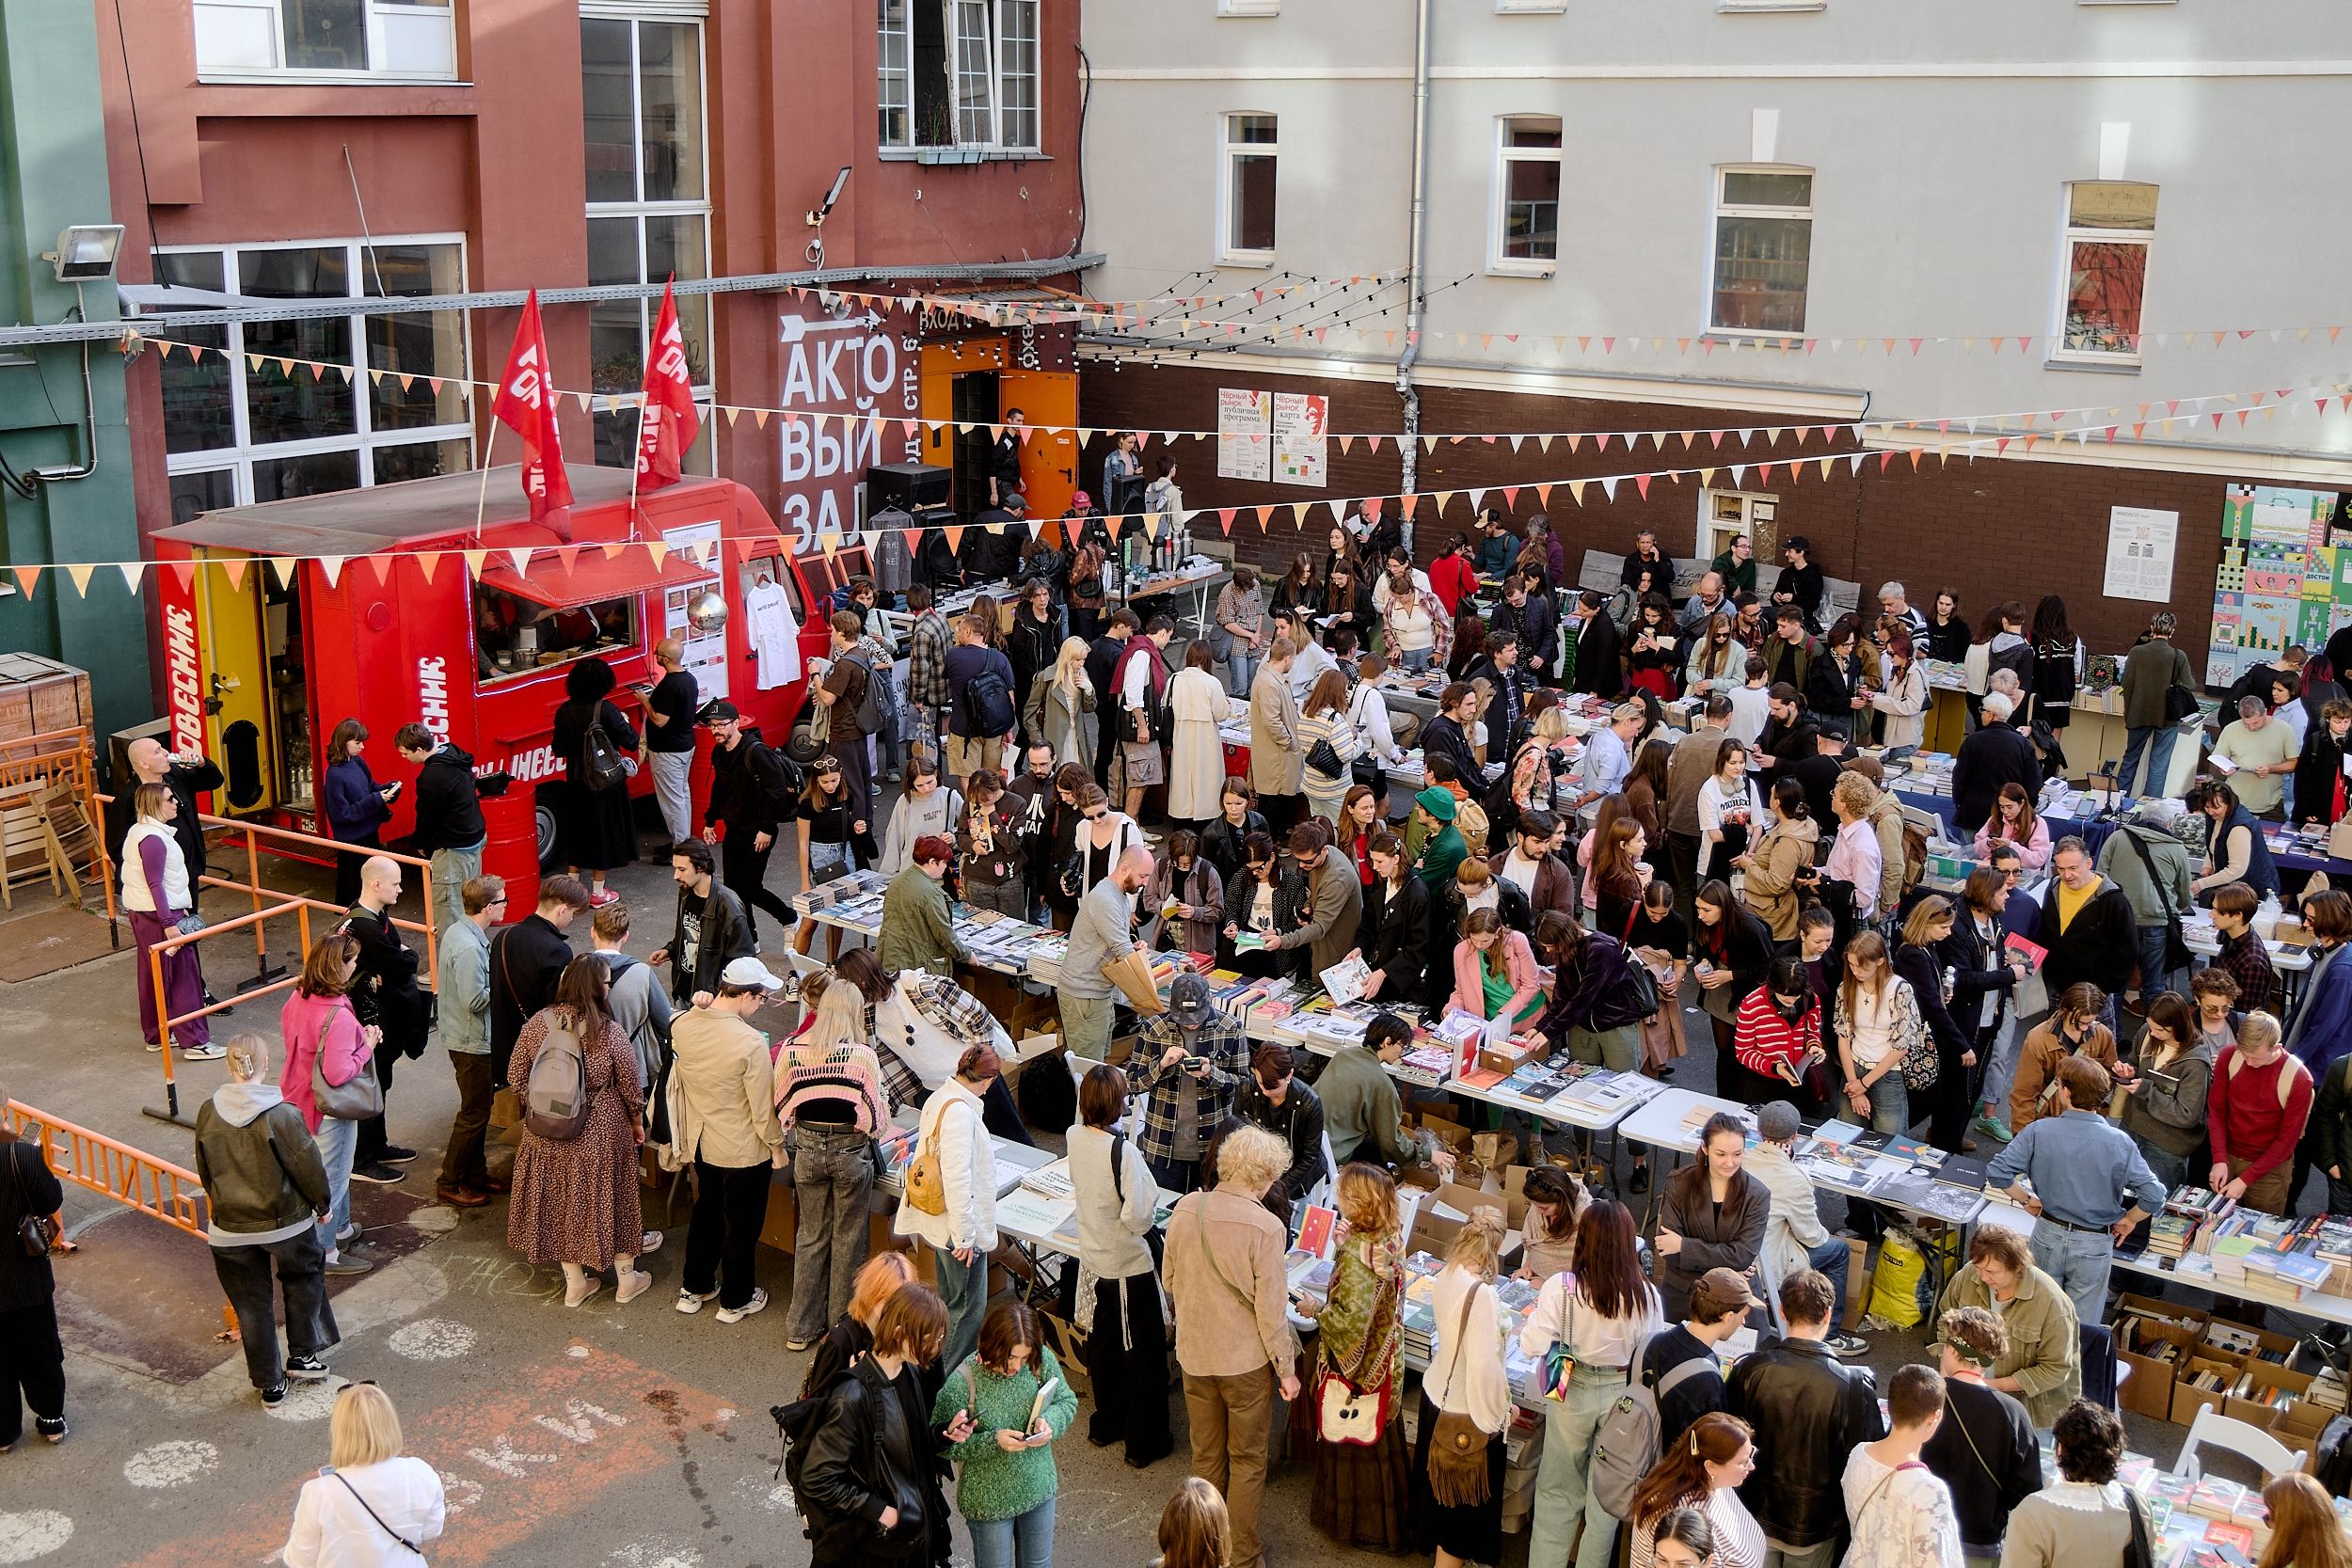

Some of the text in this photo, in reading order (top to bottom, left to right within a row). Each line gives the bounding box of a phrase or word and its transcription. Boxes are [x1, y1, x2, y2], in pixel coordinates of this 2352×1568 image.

[781, 333, 897, 406] АКТО
[1219, 390, 1248, 400] Чёрный
[1275, 394, 1305, 404] Чёрный
[1219, 399, 1243, 407] рынок
[1275, 404, 1299, 412] рынок
[1223, 405, 1261, 416] публичная
[1279, 411, 1300, 420] карта
[1223, 414, 1261, 423] программа
[782, 395, 882, 483] ВЫЙ
[166, 603, 203, 753] ОВЕСНИК
